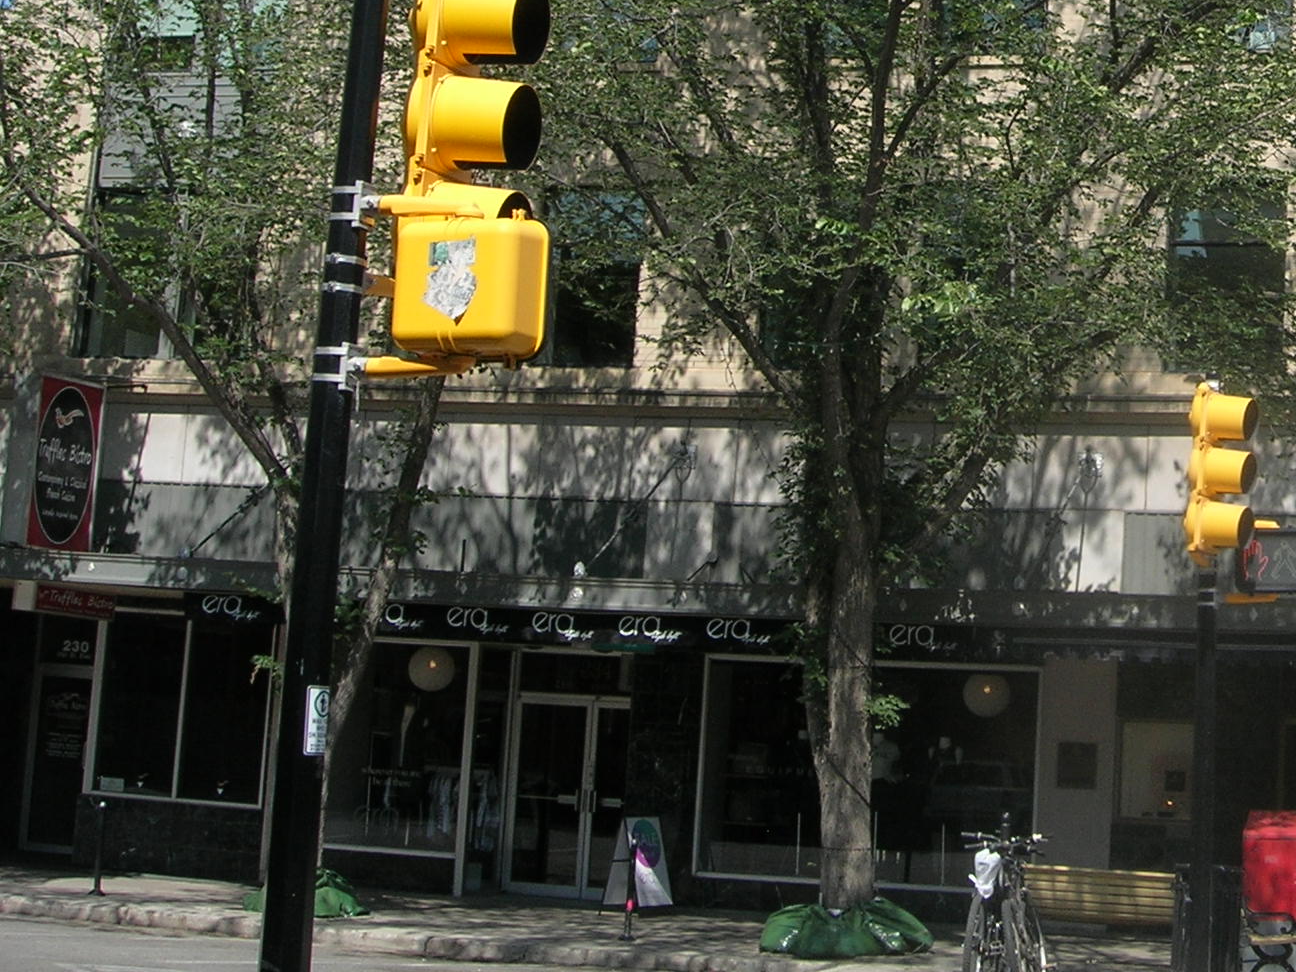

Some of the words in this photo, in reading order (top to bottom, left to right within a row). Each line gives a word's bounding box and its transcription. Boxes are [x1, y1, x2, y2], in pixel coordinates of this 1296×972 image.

[202, 595, 242, 614] era
[446, 606, 488, 628] era
[532, 611, 574, 633] era
[618, 616, 661, 636] era
[706, 618, 751, 639] era
[889, 624, 935, 646] era
[62, 639, 90, 653] 230
